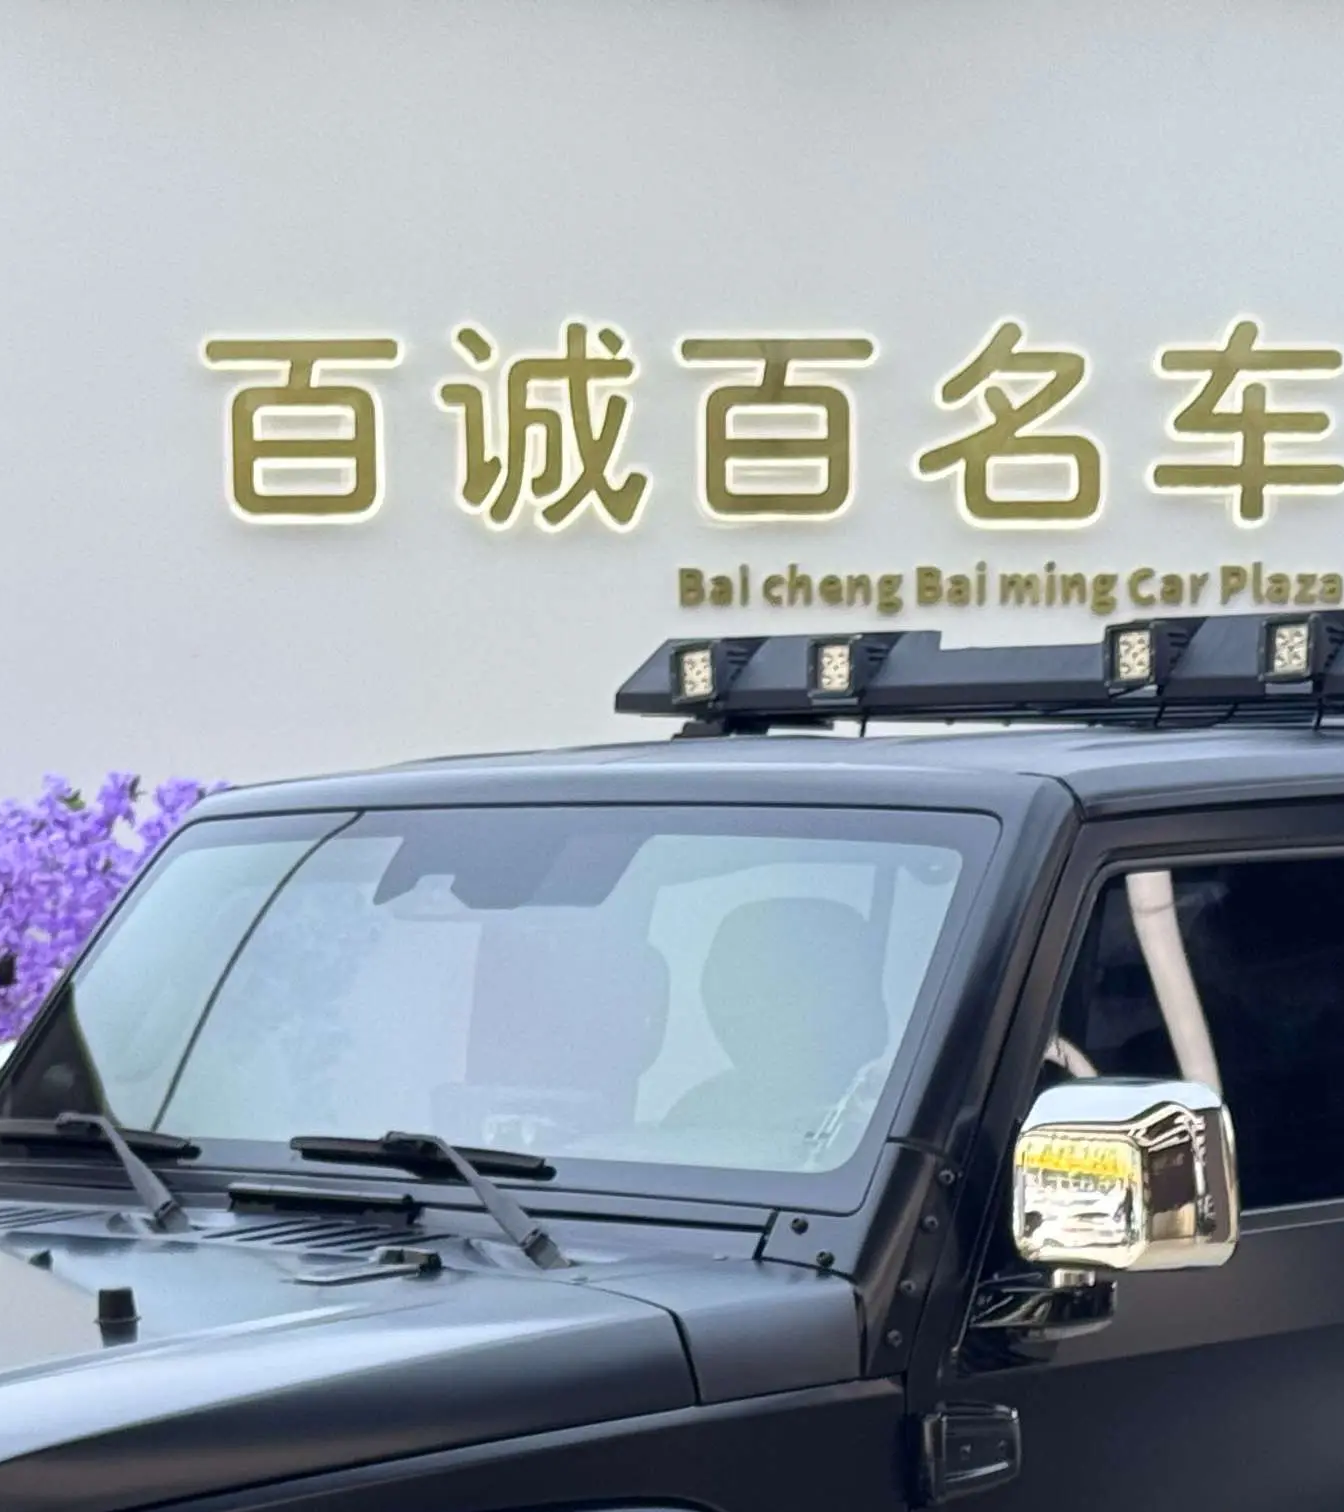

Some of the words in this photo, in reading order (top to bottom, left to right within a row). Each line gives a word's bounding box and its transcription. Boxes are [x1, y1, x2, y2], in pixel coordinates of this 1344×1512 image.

[678, 563, 750, 607] Bai
[762, 563, 904, 616] cheng
[916, 560, 987, 606] Bai
[999, 560, 1118, 615] ming
[1128, 567, 1209, 606] Car
[1220, 561, 1344, 605] Plaza
